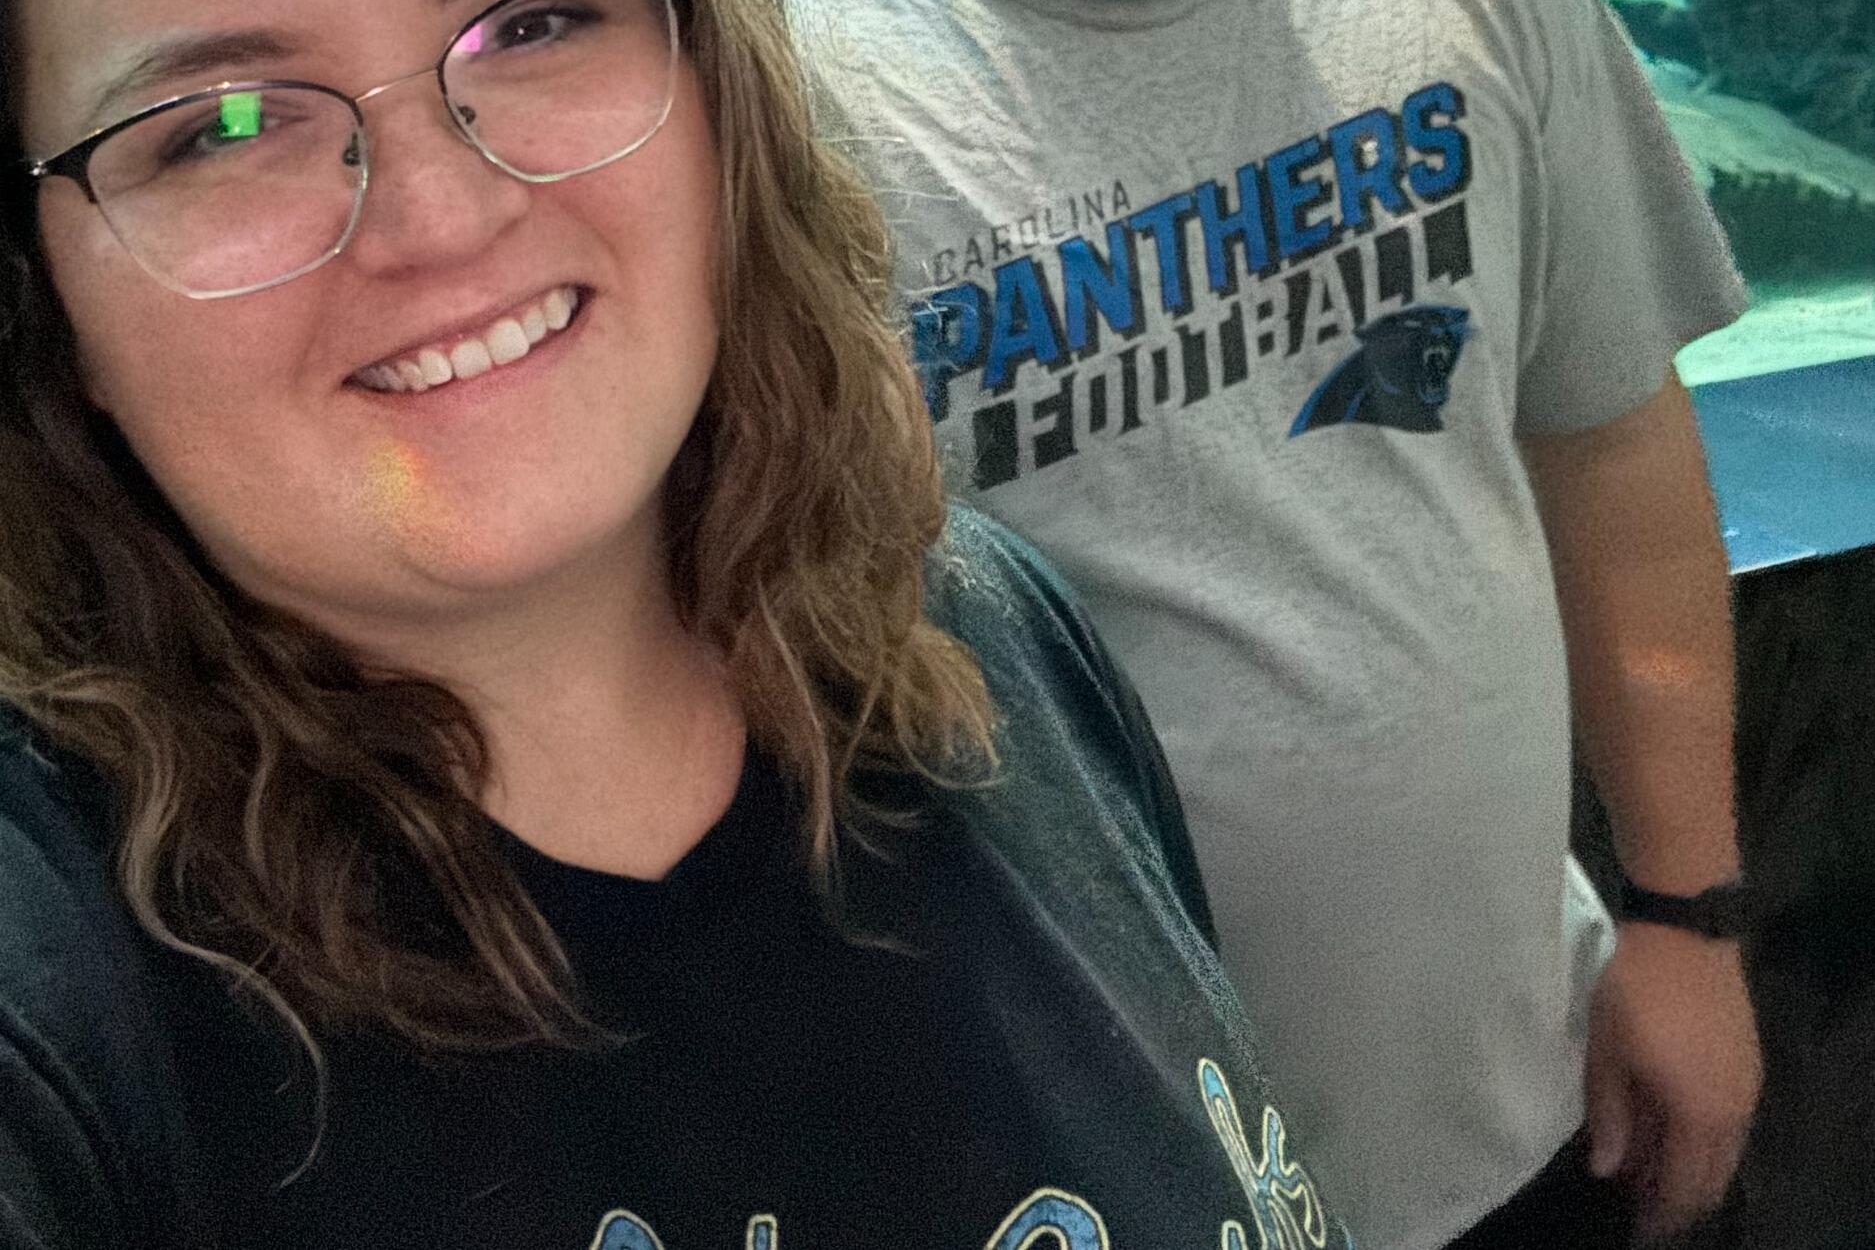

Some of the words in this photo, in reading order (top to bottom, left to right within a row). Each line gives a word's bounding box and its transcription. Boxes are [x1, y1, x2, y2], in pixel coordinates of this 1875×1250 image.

[911, 81, 1474, 425] PANTHERS
[932, 178, 1132, 285] CAROLINA
[973, 201, 1473, 492] FOOTBALL
